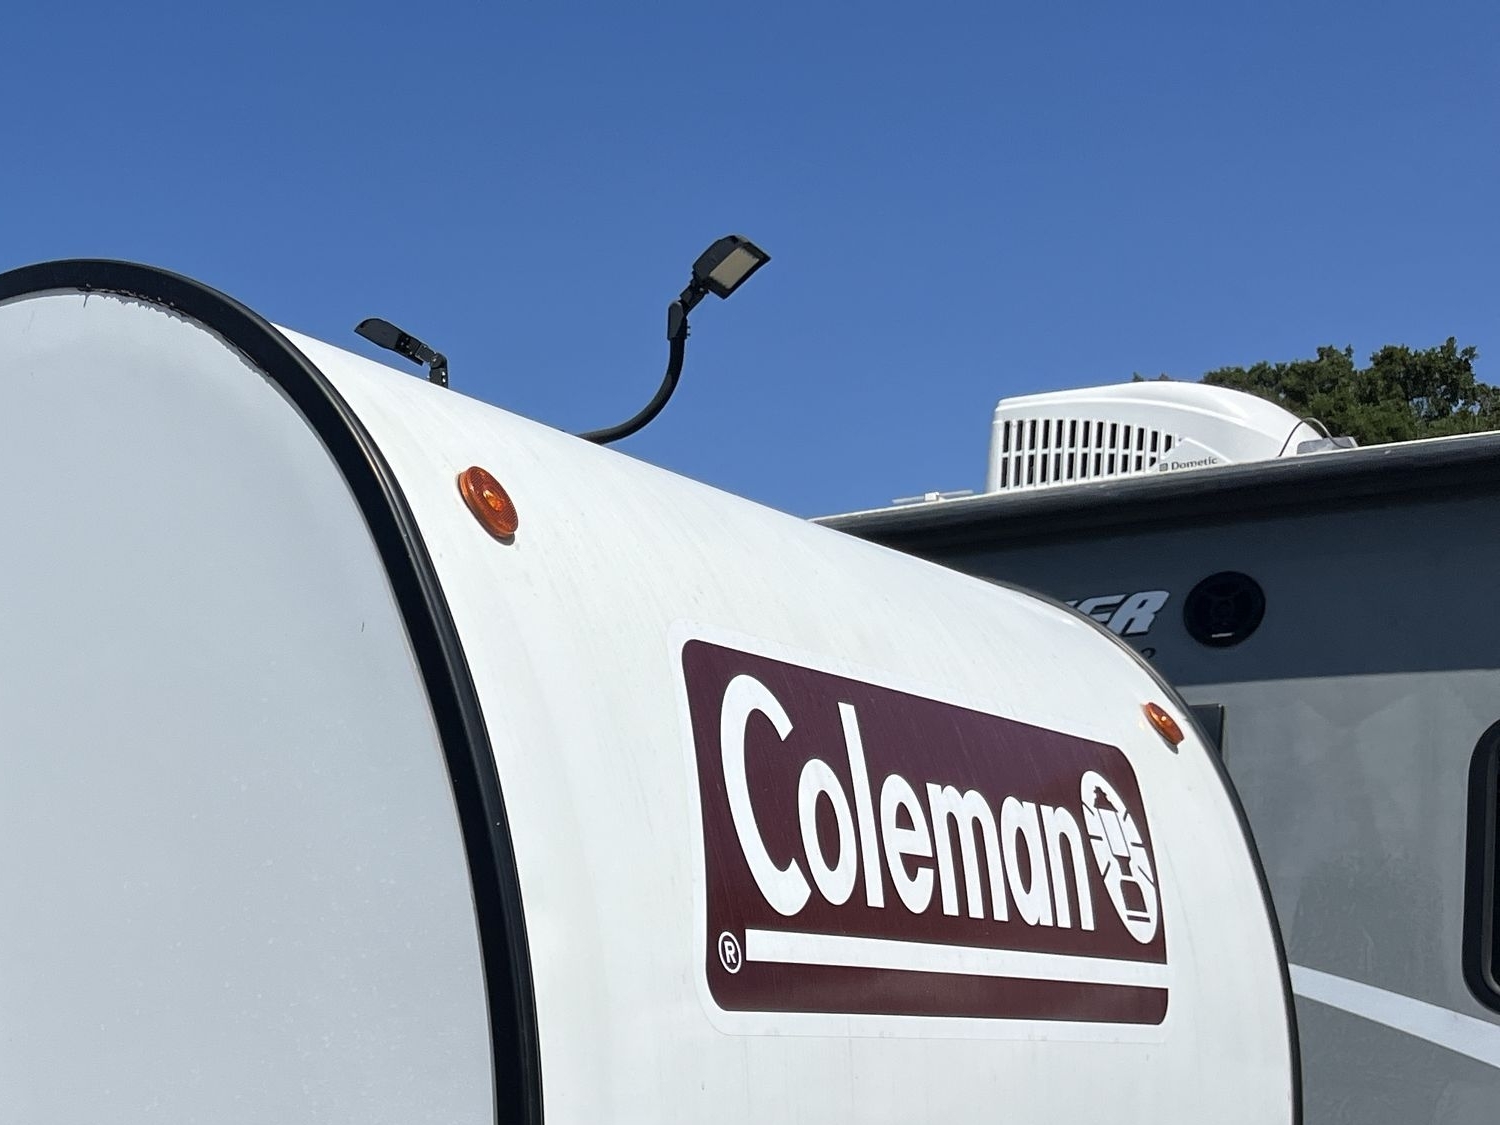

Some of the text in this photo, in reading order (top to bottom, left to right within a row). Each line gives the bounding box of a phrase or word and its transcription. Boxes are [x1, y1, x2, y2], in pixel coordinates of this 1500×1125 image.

[1171, 456, 1218, 470] Dometic
[1065, 590, 1170, 637] ER
[720, 673, 1095, 931] Coleman
